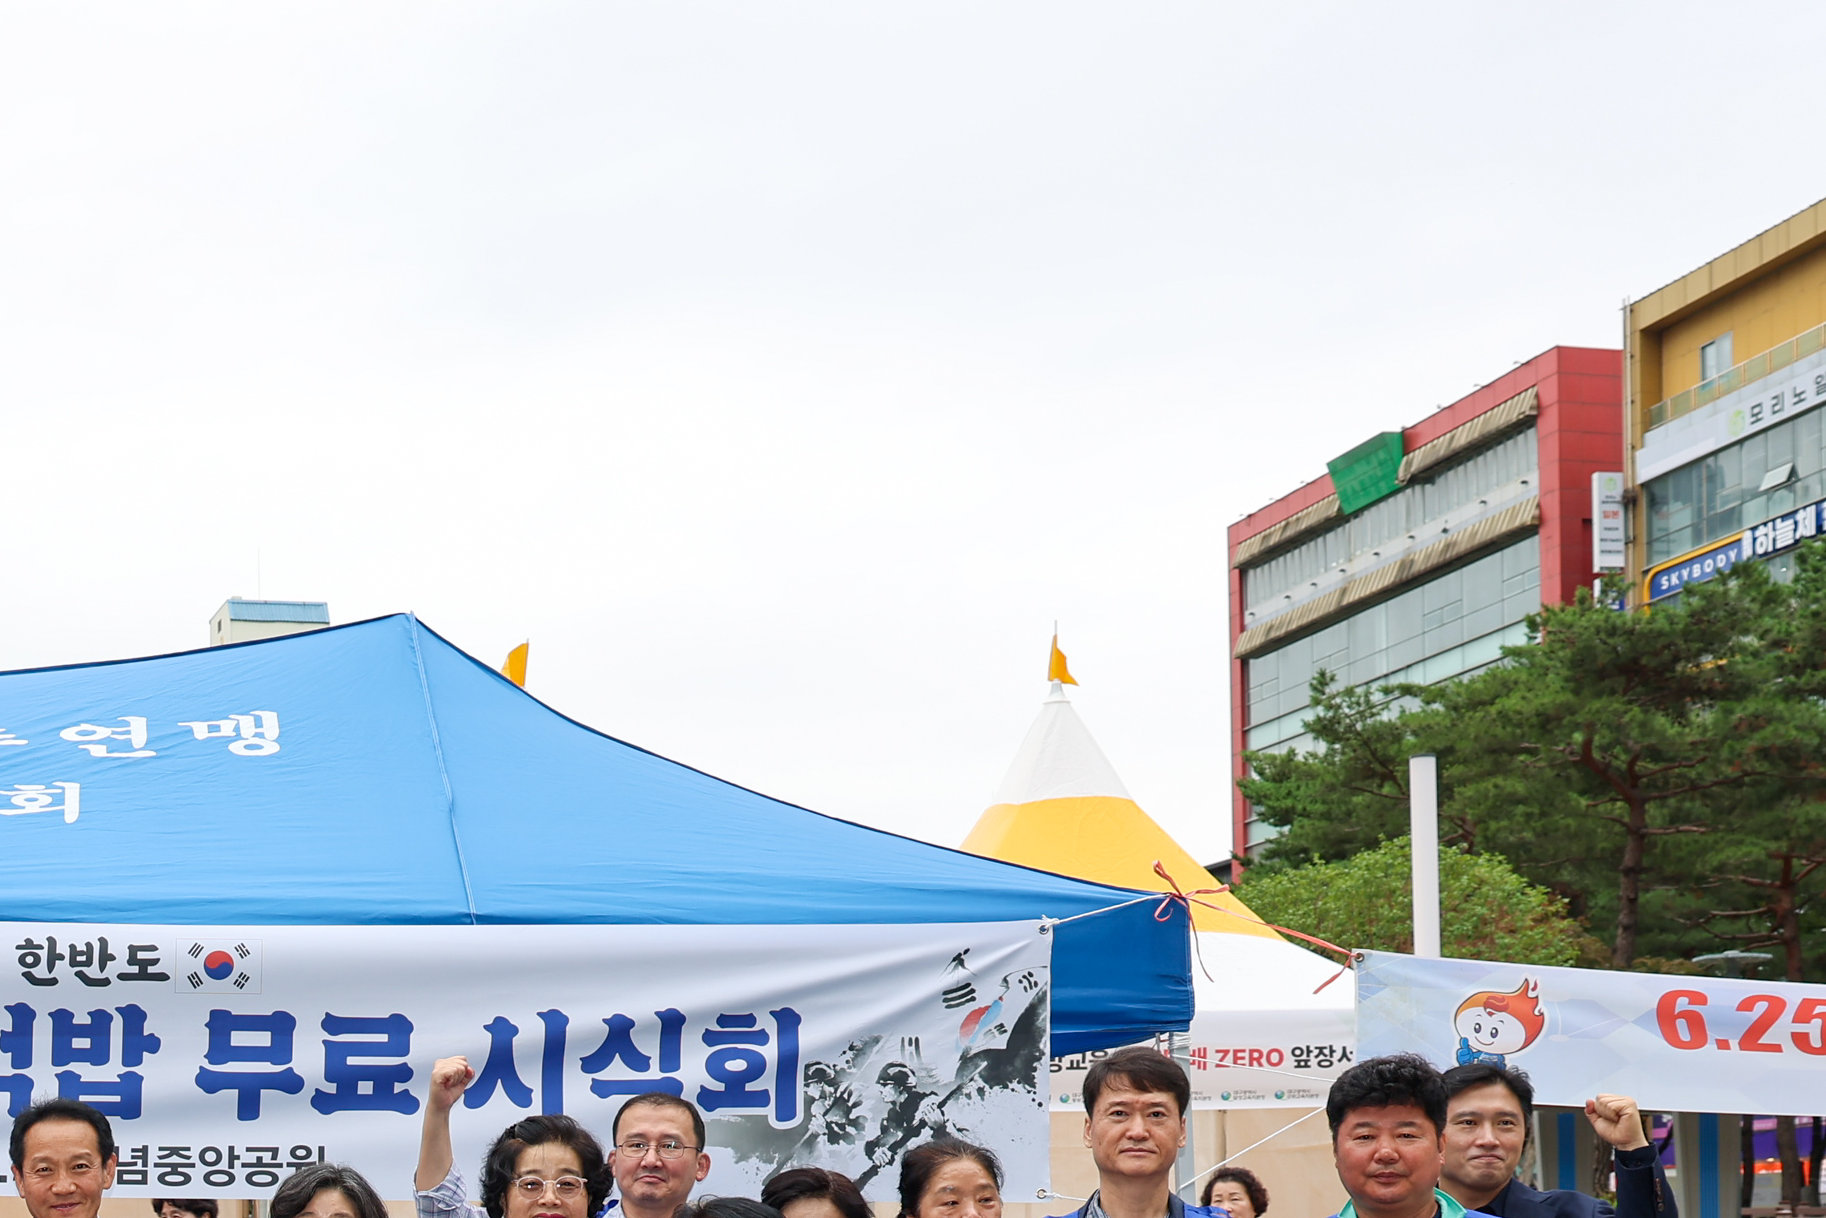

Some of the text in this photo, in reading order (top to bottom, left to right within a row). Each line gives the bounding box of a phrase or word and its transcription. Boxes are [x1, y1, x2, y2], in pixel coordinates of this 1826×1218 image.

[1660, 547, 1739, 590] SKYBODY
[16, 937, 170, 984] 한반도
[1656, 989, 1826, 1056] 6.25
[195, 1010, 420, 1122] 무료
[462, 1008, 801, 1126] 시식회
[1215, 1047, 1285, 1069] ZERO
